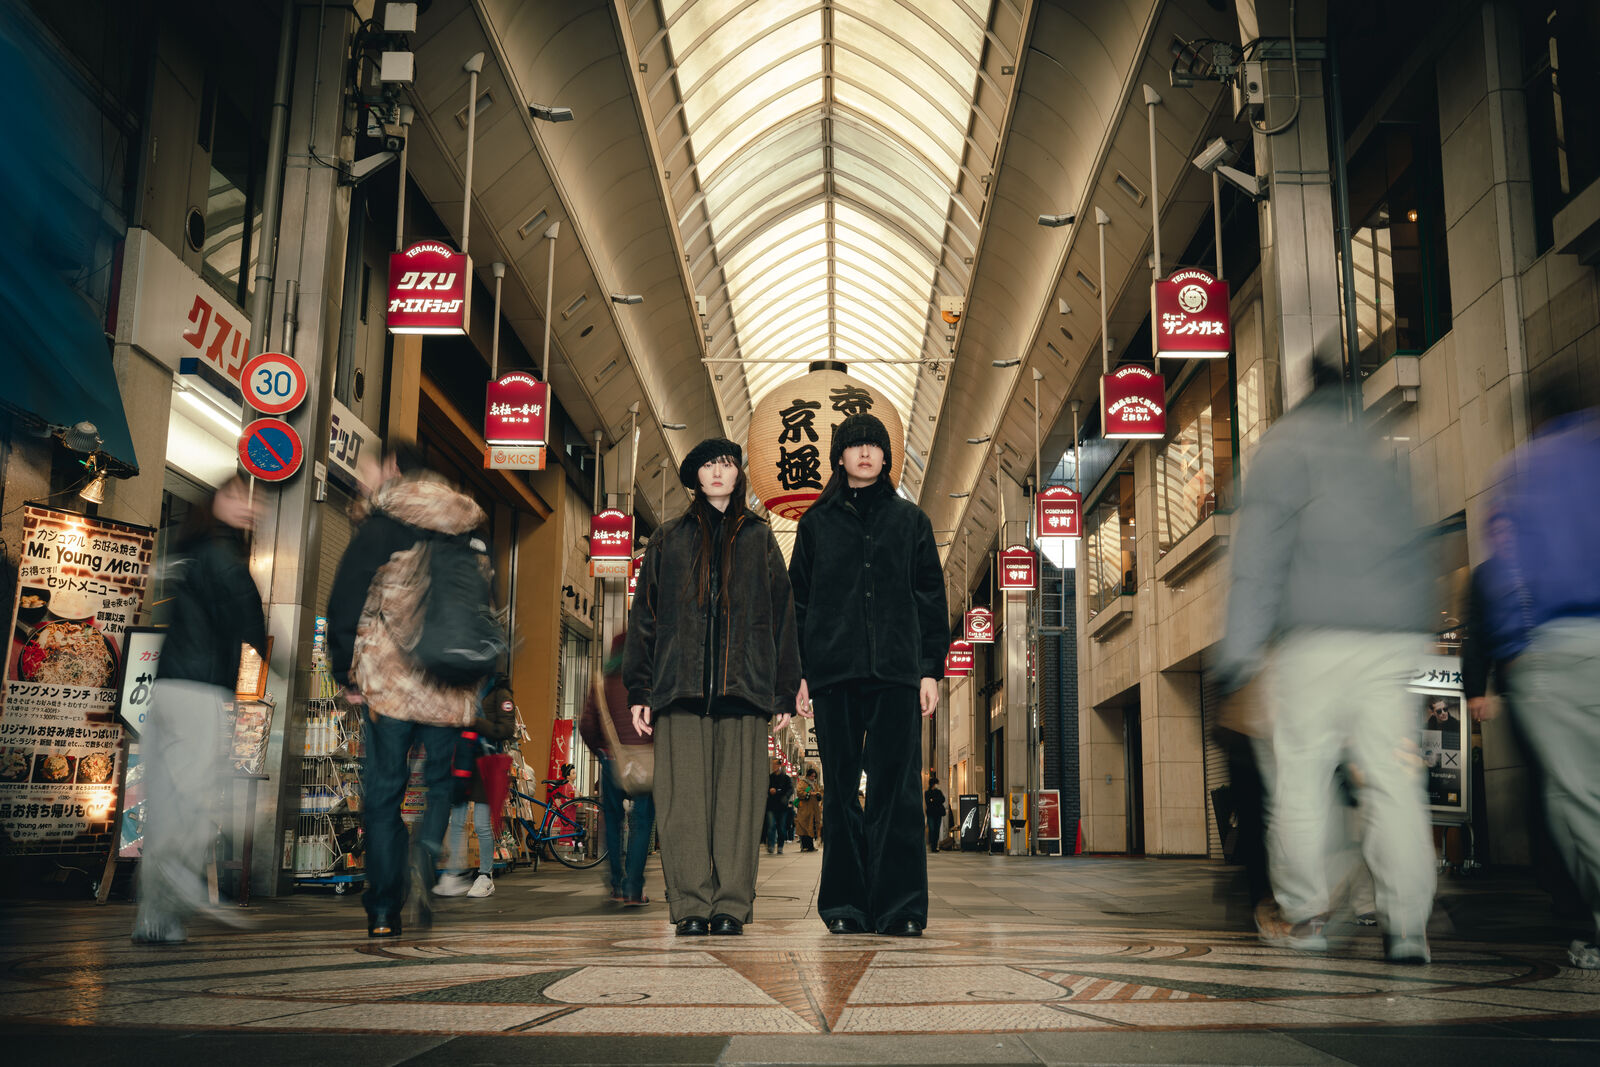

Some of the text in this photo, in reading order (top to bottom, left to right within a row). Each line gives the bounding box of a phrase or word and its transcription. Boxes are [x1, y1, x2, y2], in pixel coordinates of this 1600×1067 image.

[405, 245, 452, 258] TERAMACHI
[396, 271, 457, 290] クスリ
[1171, 271, 1213, 285] TERAMACHI
[388, 298, 463, 313] オーエスドラッグ
[1162, 320, 1225, 335] サンメガネ
[182, 294, 251, 382] クスリ
[1115, 367, 1152, 379] TERAMACHI
[256, 369, 291, 397] 30
[499, 375, 535, 387] TERAMACHI
[776, 399, 824, 491] 京極
[507, 454, 536, 465] KICS
[1048, 516, 1071, 528] 寺町
[92, 539, 138, 557] お好み焼き
[27, 541, 140, 575] Mr. Young Men
[47, 574, 118, 596] セットメニュー
[97, 611, 126, 623] 創業以来
[9, 684, 60, 698] ヤングメン
[62, 688, 91, 700] ランチ
[0, 723, 119, 740] リジナルお好み焼きいっぱい!!
